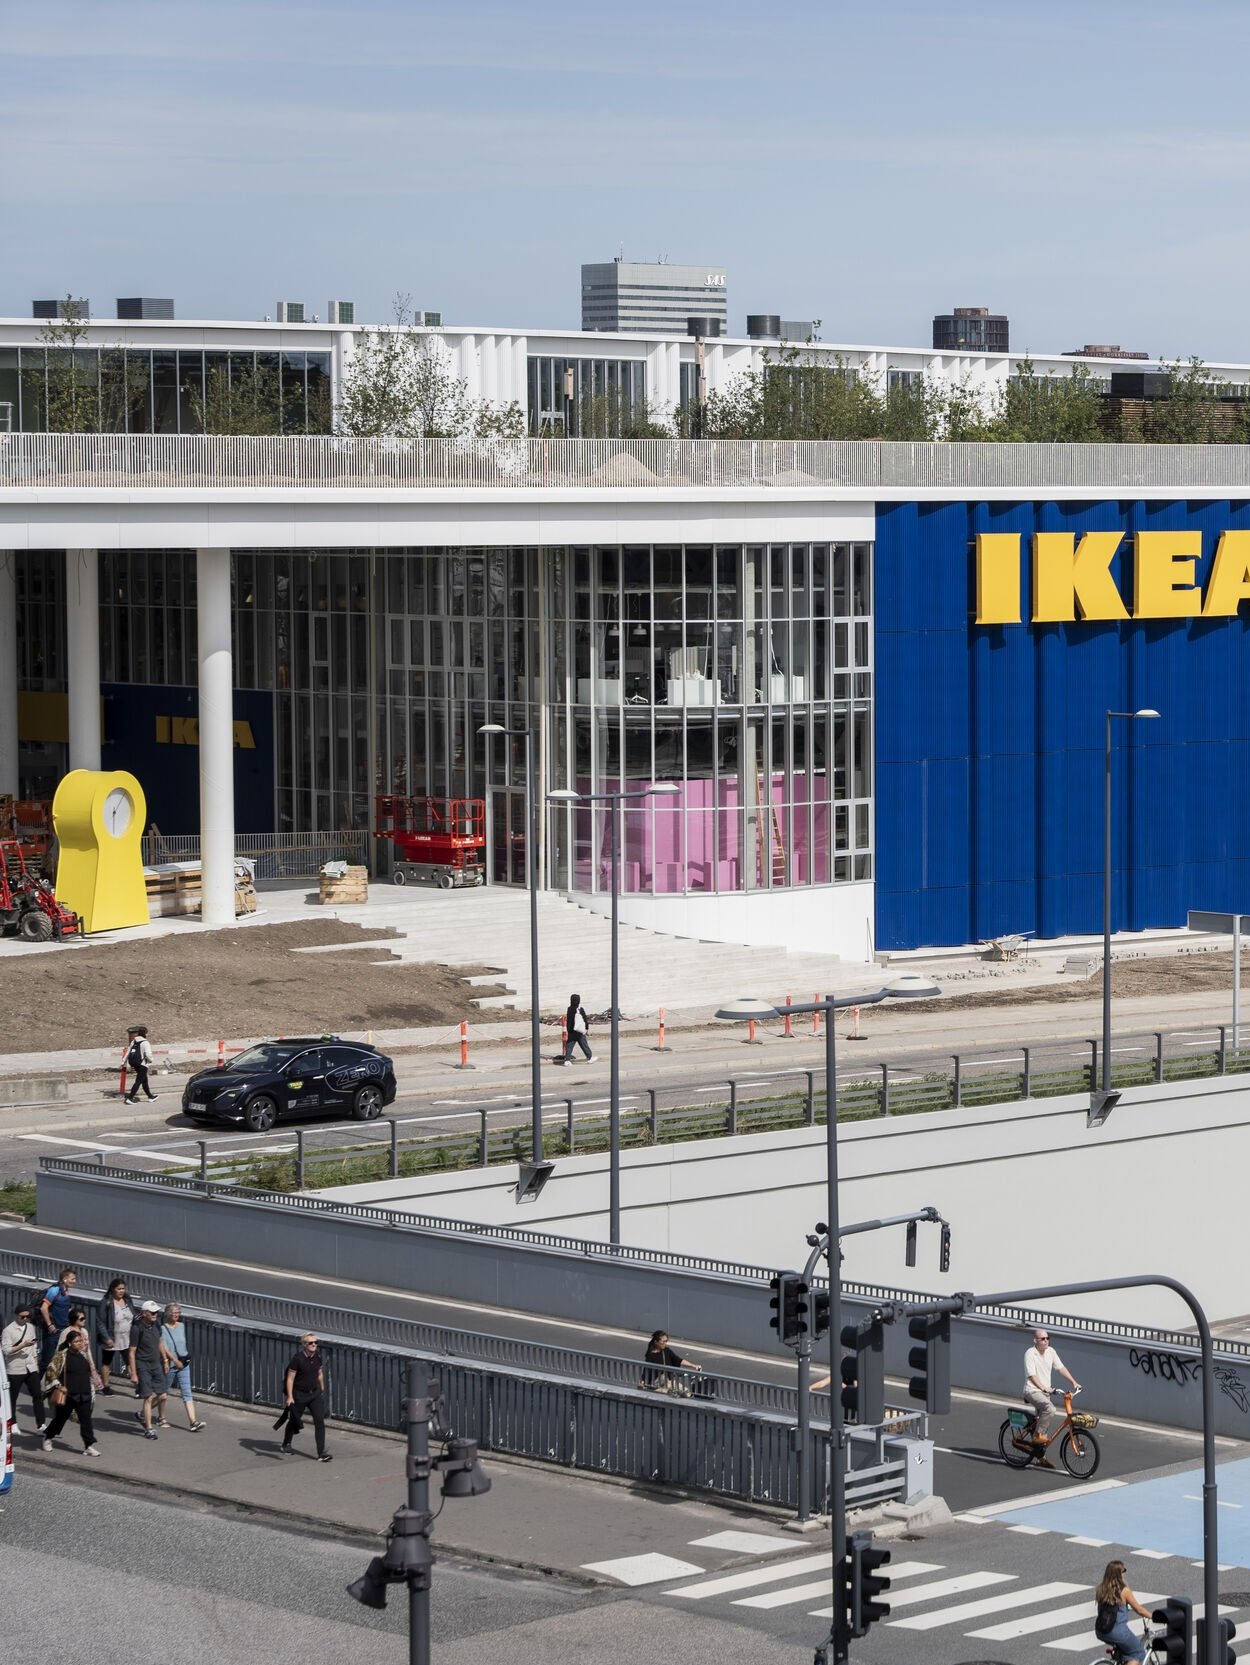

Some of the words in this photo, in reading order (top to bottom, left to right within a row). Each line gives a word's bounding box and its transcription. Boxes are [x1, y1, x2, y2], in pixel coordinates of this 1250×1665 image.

[704, 274, 726, 286] SAS
[155, 715, 257, 749] IKA
[334, 1061, 381, 1087] ZERO
